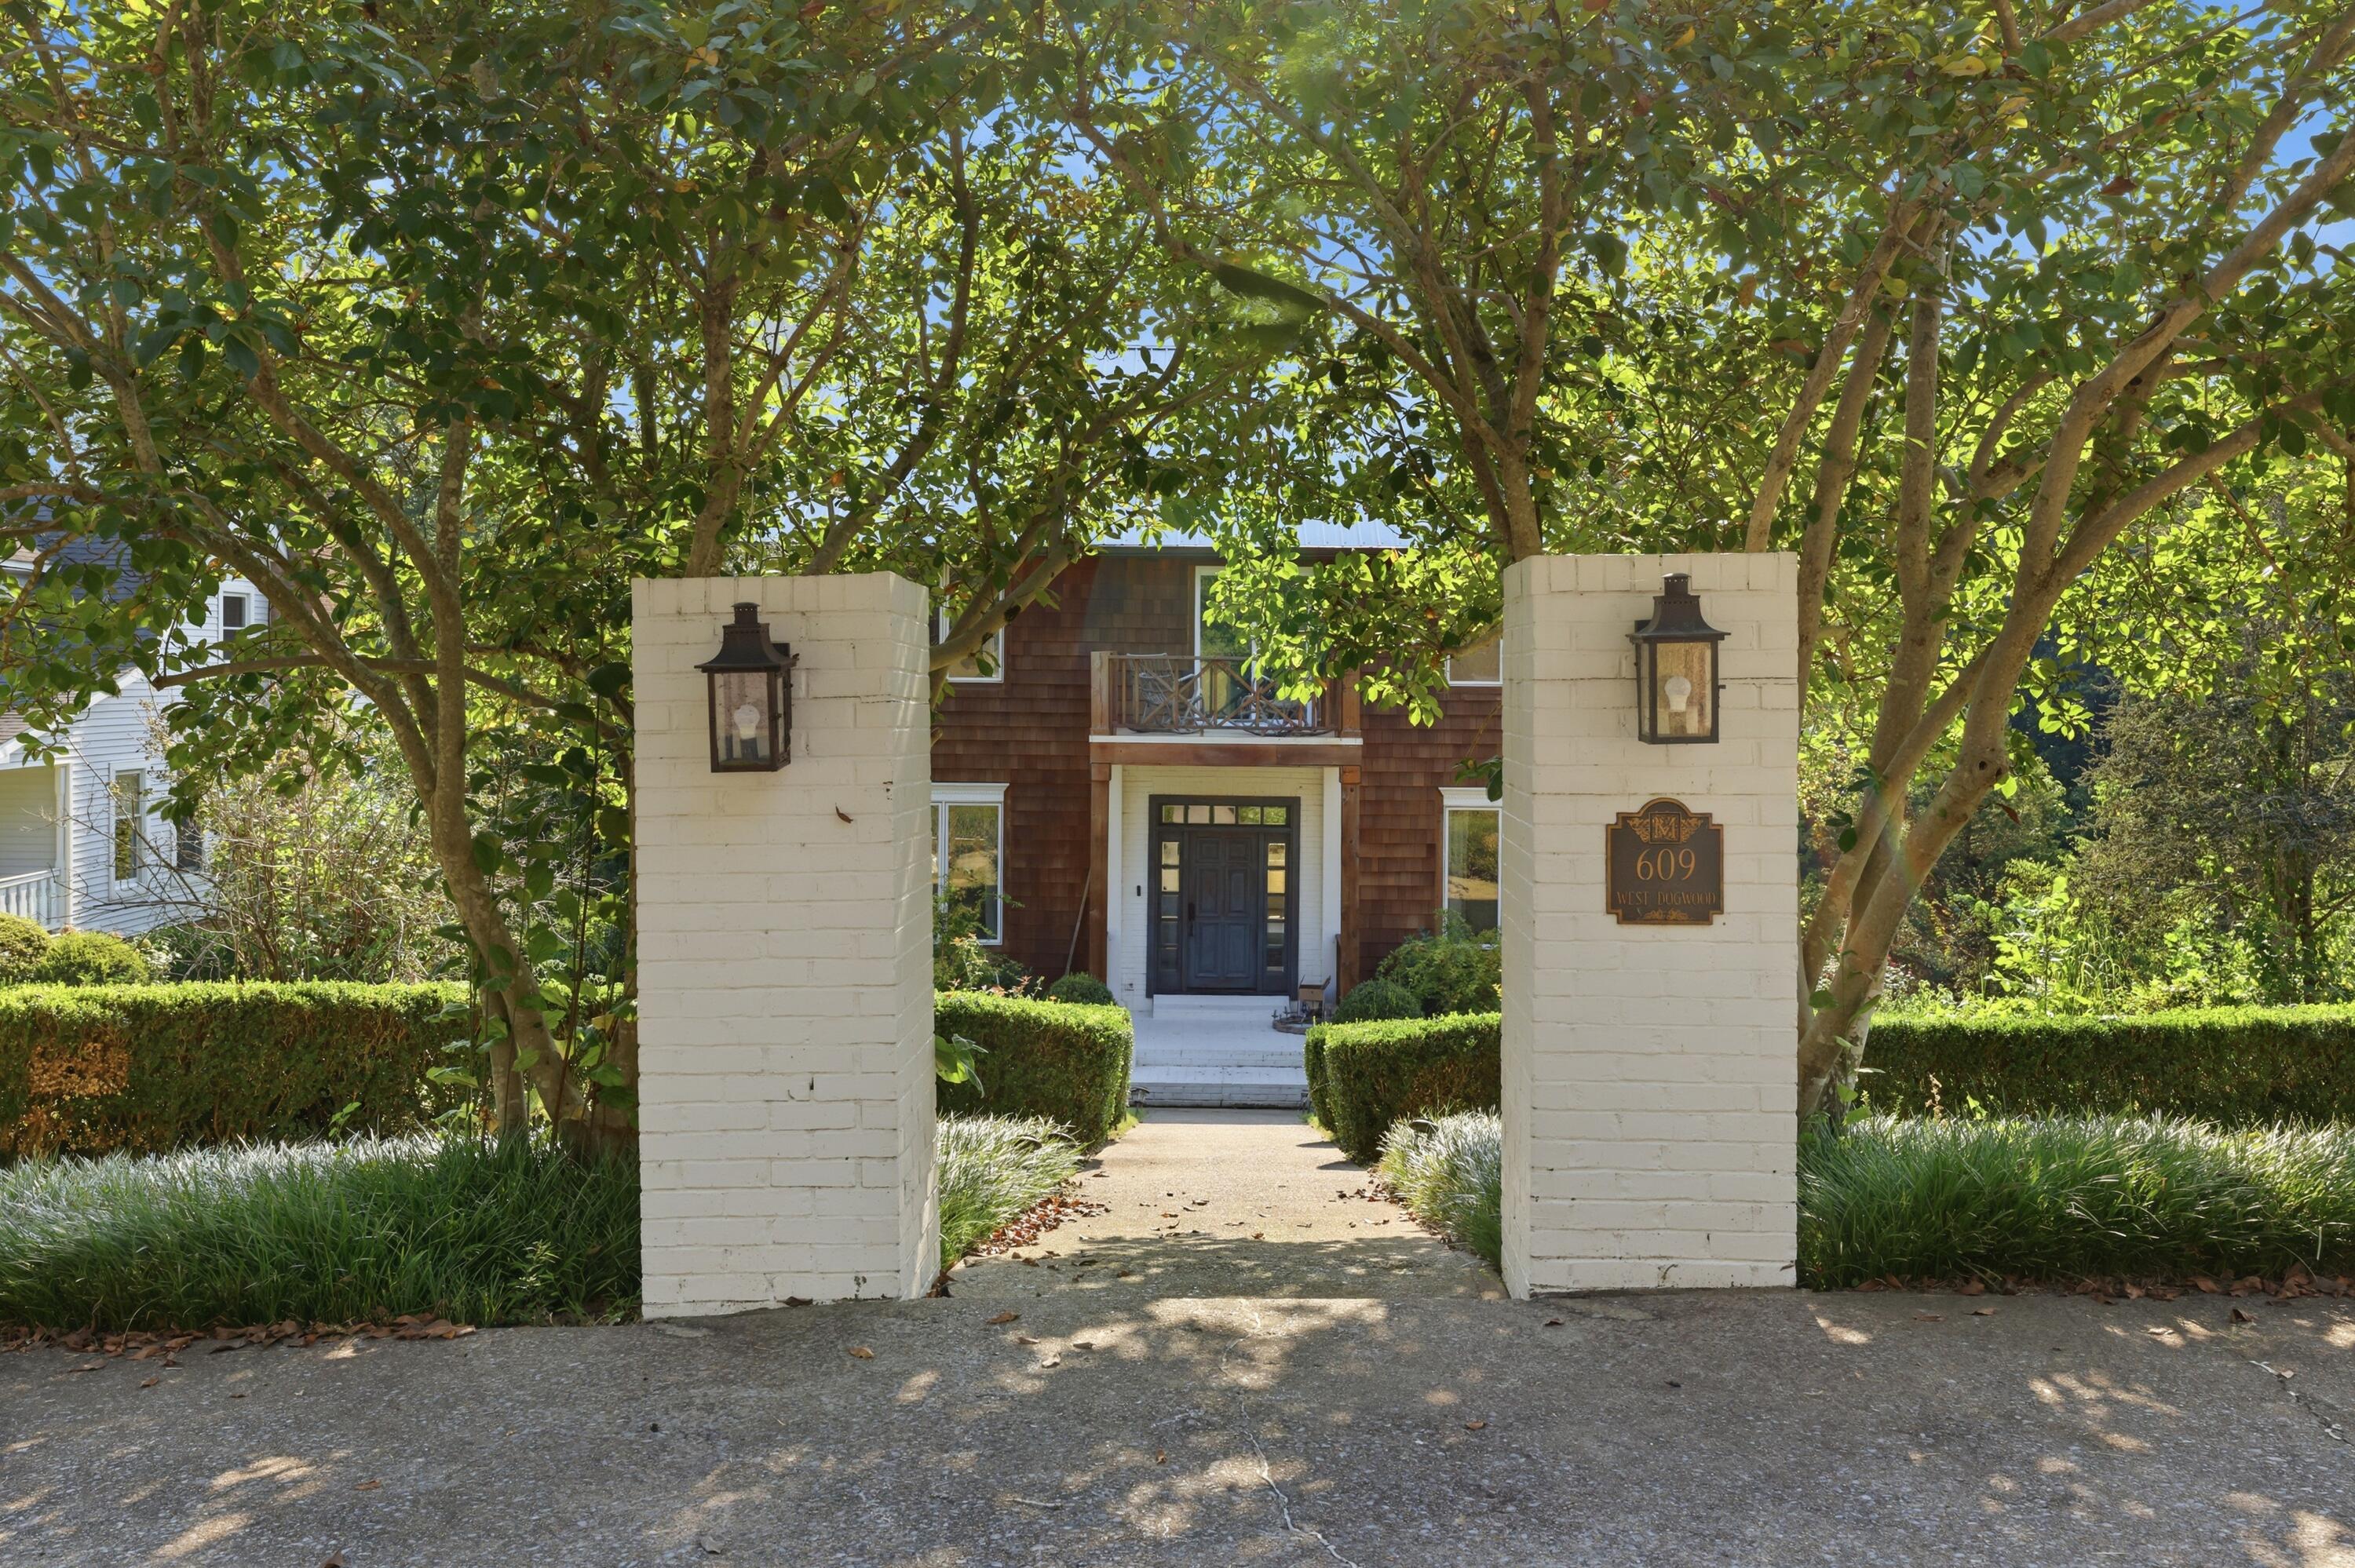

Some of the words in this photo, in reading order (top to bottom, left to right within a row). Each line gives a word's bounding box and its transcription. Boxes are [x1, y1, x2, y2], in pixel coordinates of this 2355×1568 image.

[1637, 848, 1696, 881] 609
[1617, 892, 1649, 906] WEST
[1657, 892, 1716, 906] DOGWOOD
